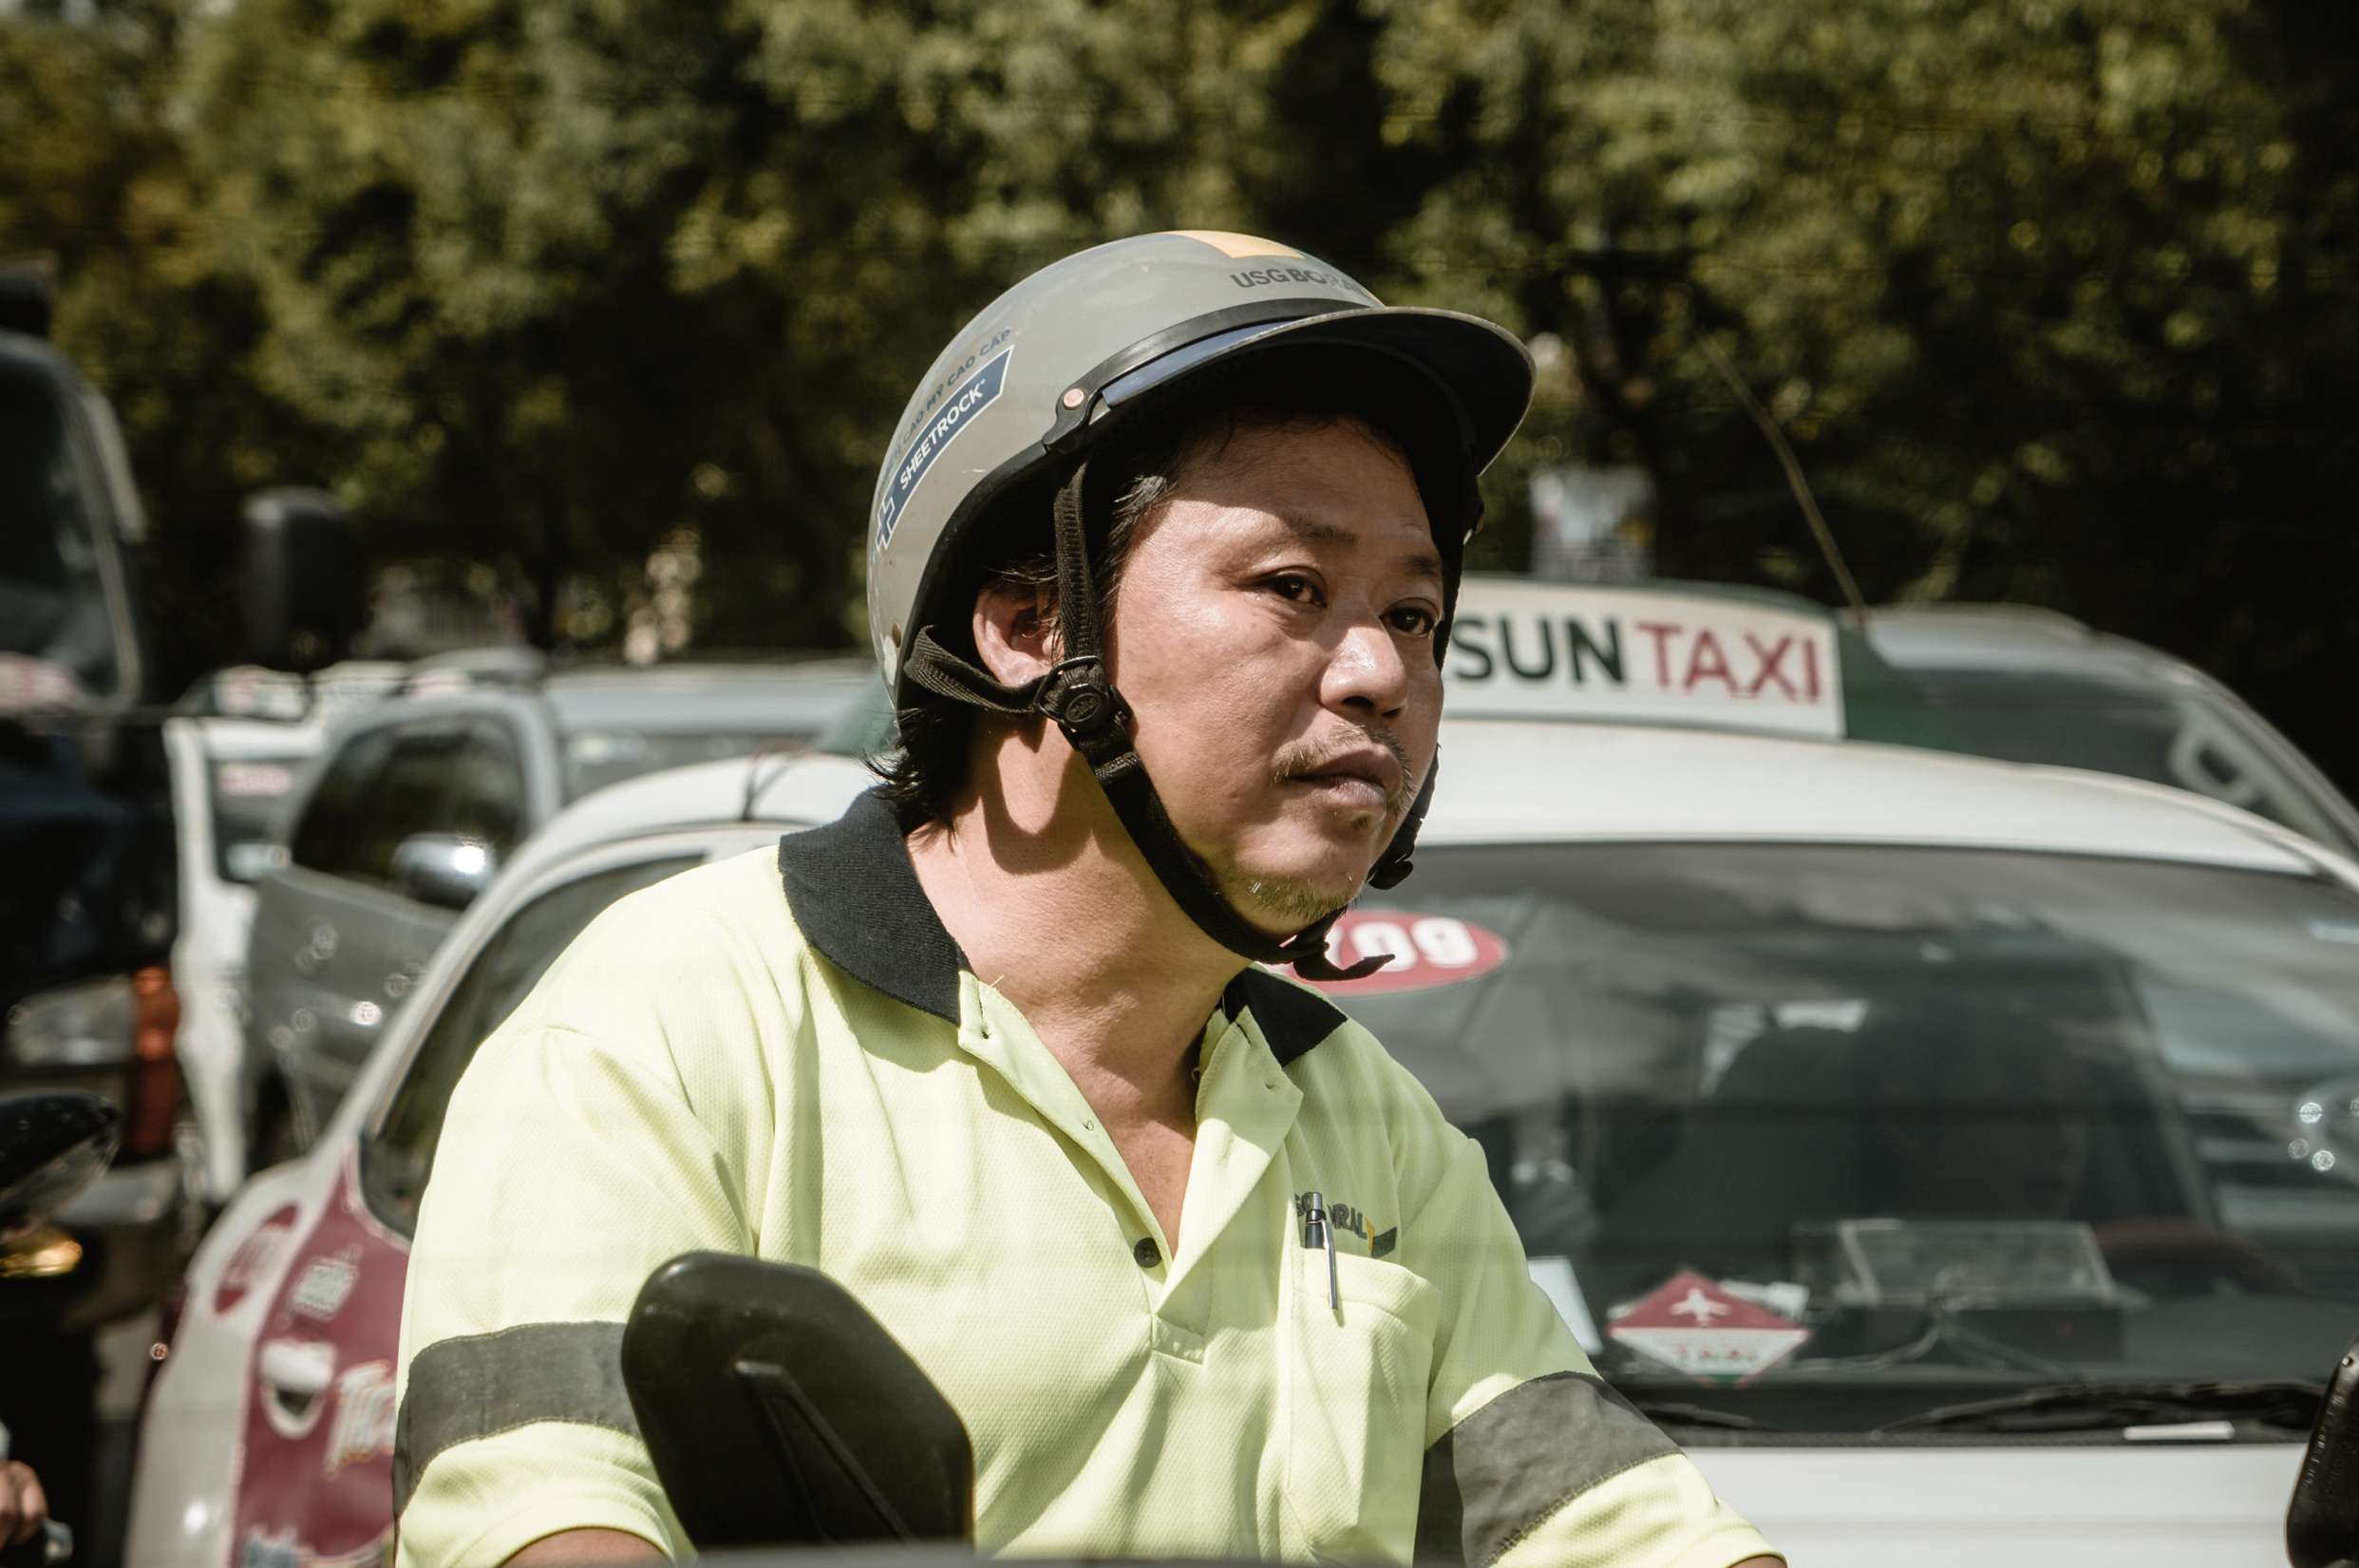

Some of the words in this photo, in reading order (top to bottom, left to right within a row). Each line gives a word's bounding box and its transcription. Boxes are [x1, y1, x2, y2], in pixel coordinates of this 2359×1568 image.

[1230, 269, 1290, 288] USG
[902, 411, 924, 445] CAO
[947, 355, 976, 387] CAO
[1451, 615, 1626, 684] SUN
[1634, 621, 1820, 703] TAXI
